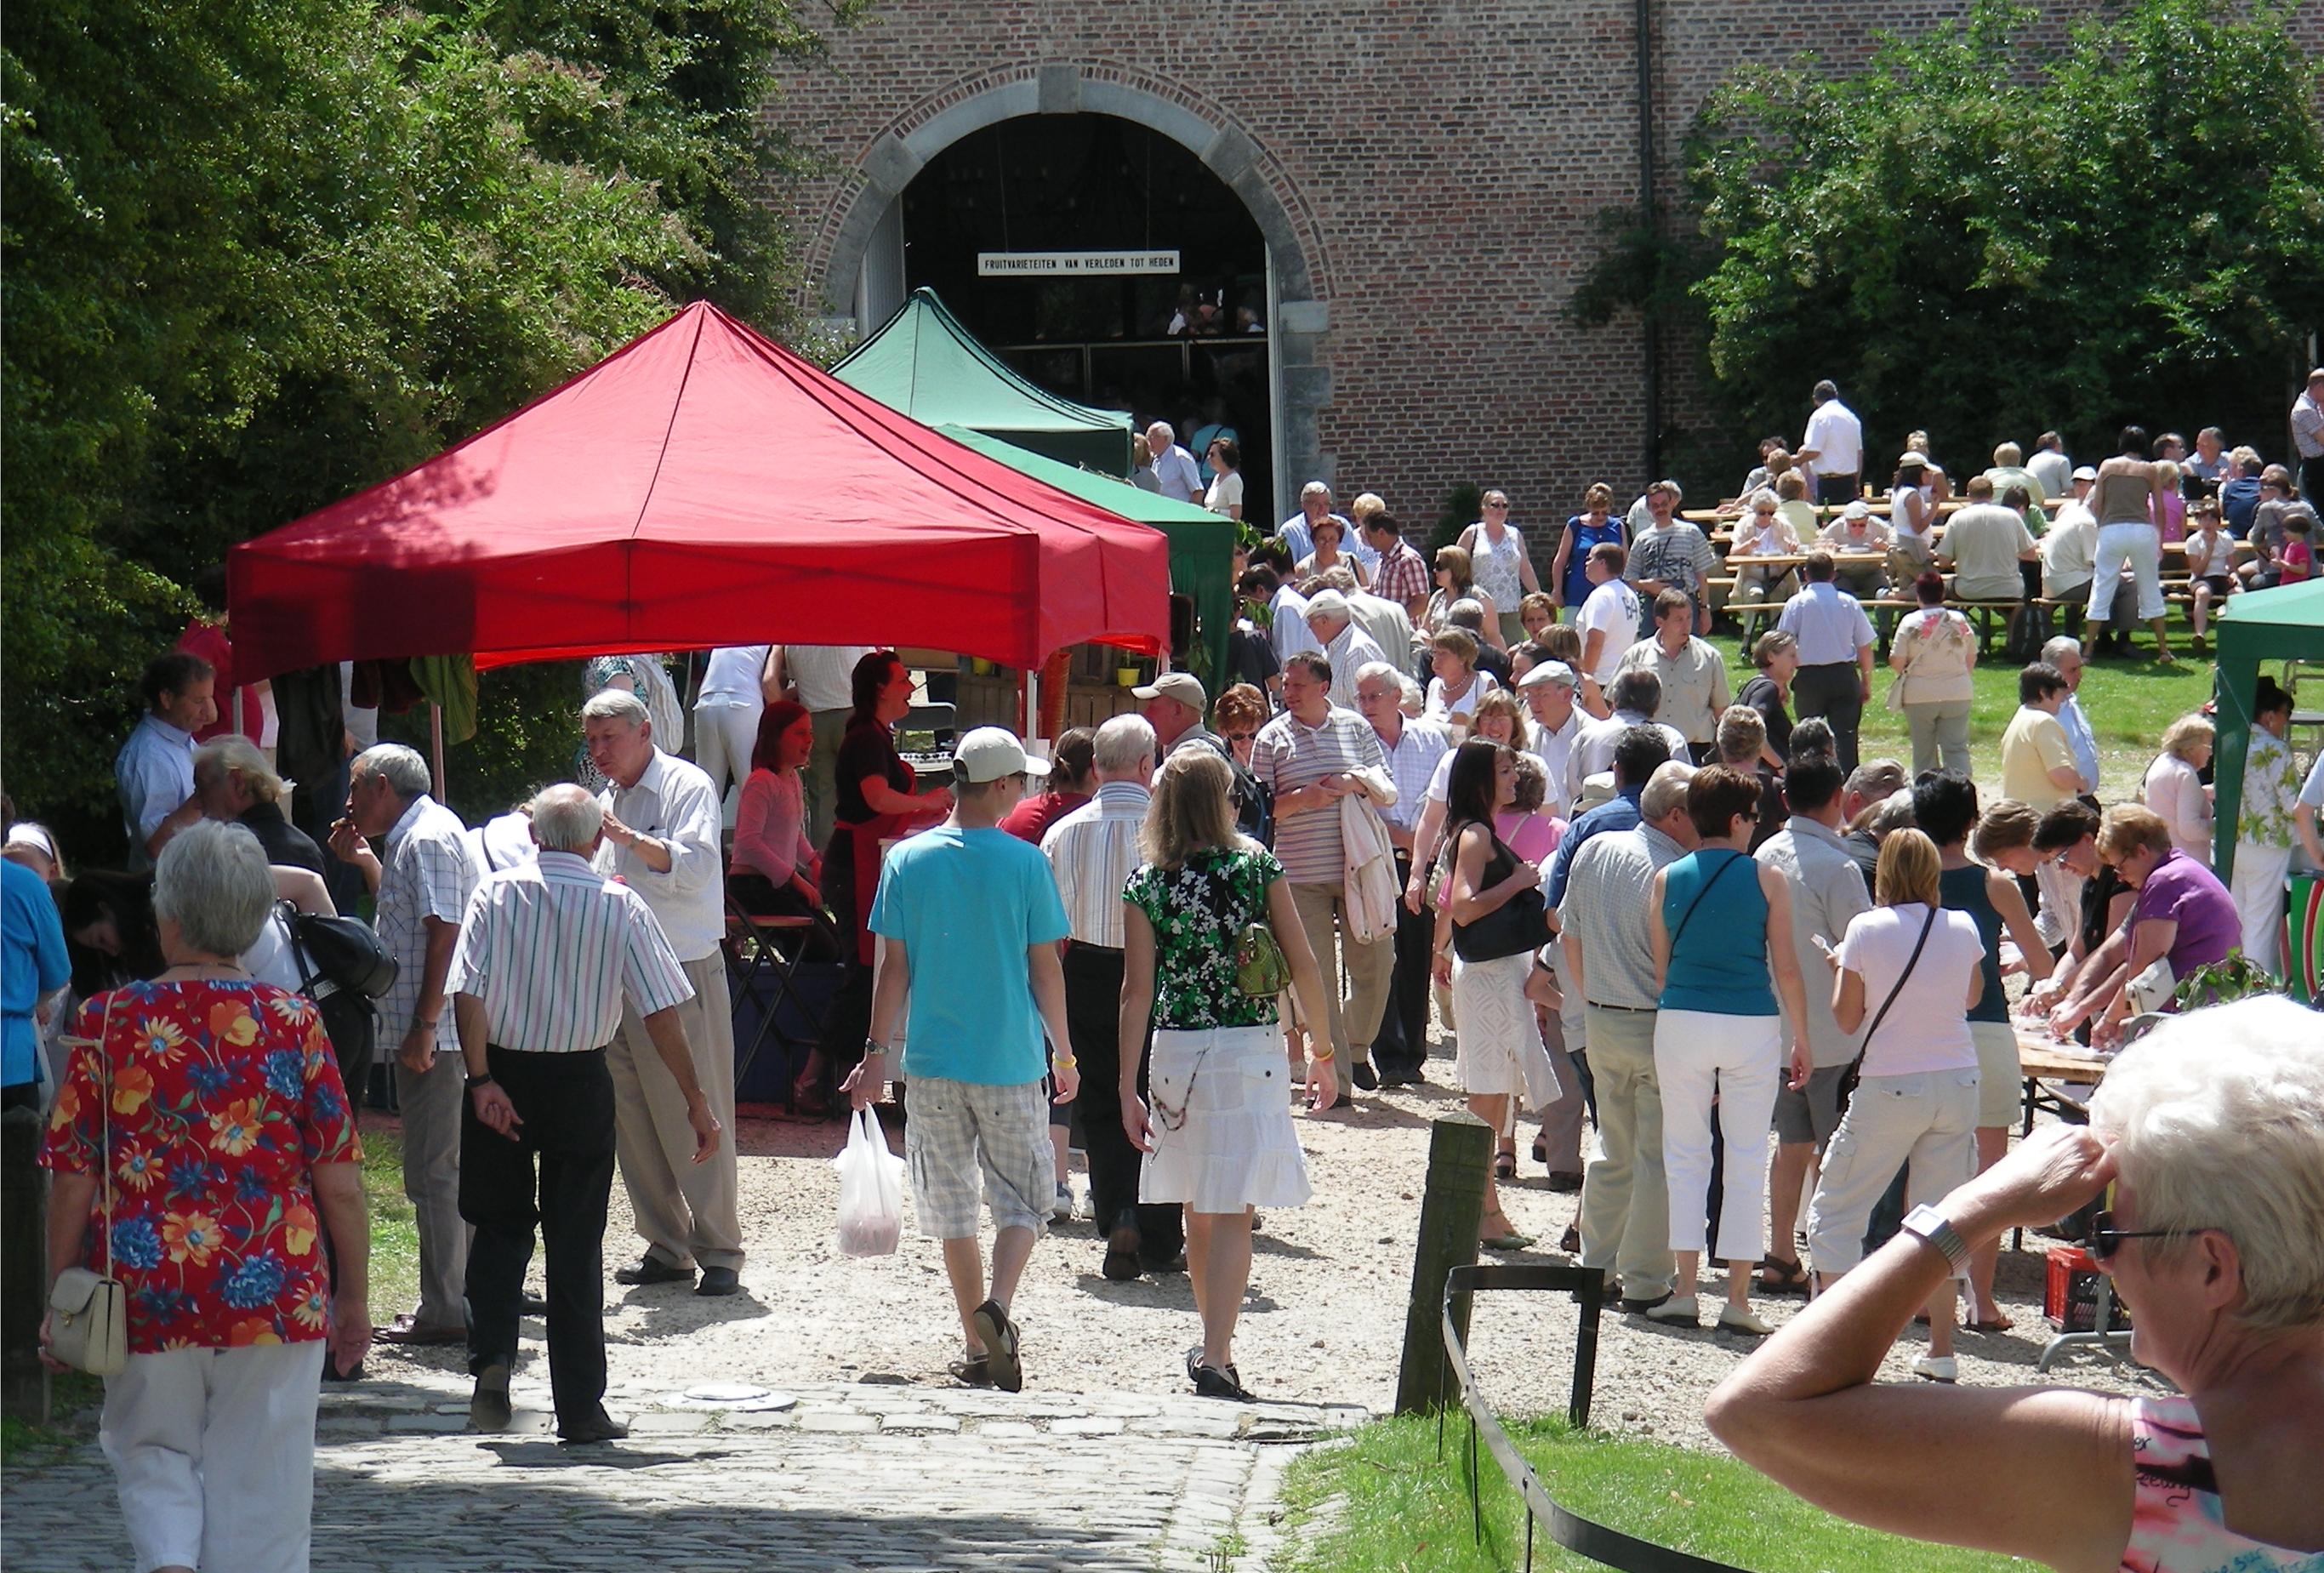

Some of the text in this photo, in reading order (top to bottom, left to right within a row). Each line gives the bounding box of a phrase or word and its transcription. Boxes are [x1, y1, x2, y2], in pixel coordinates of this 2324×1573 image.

[985, 257, 1174, 270] FRUITVARIETEITEN VAN VERLEDEN TOT HEDEN
